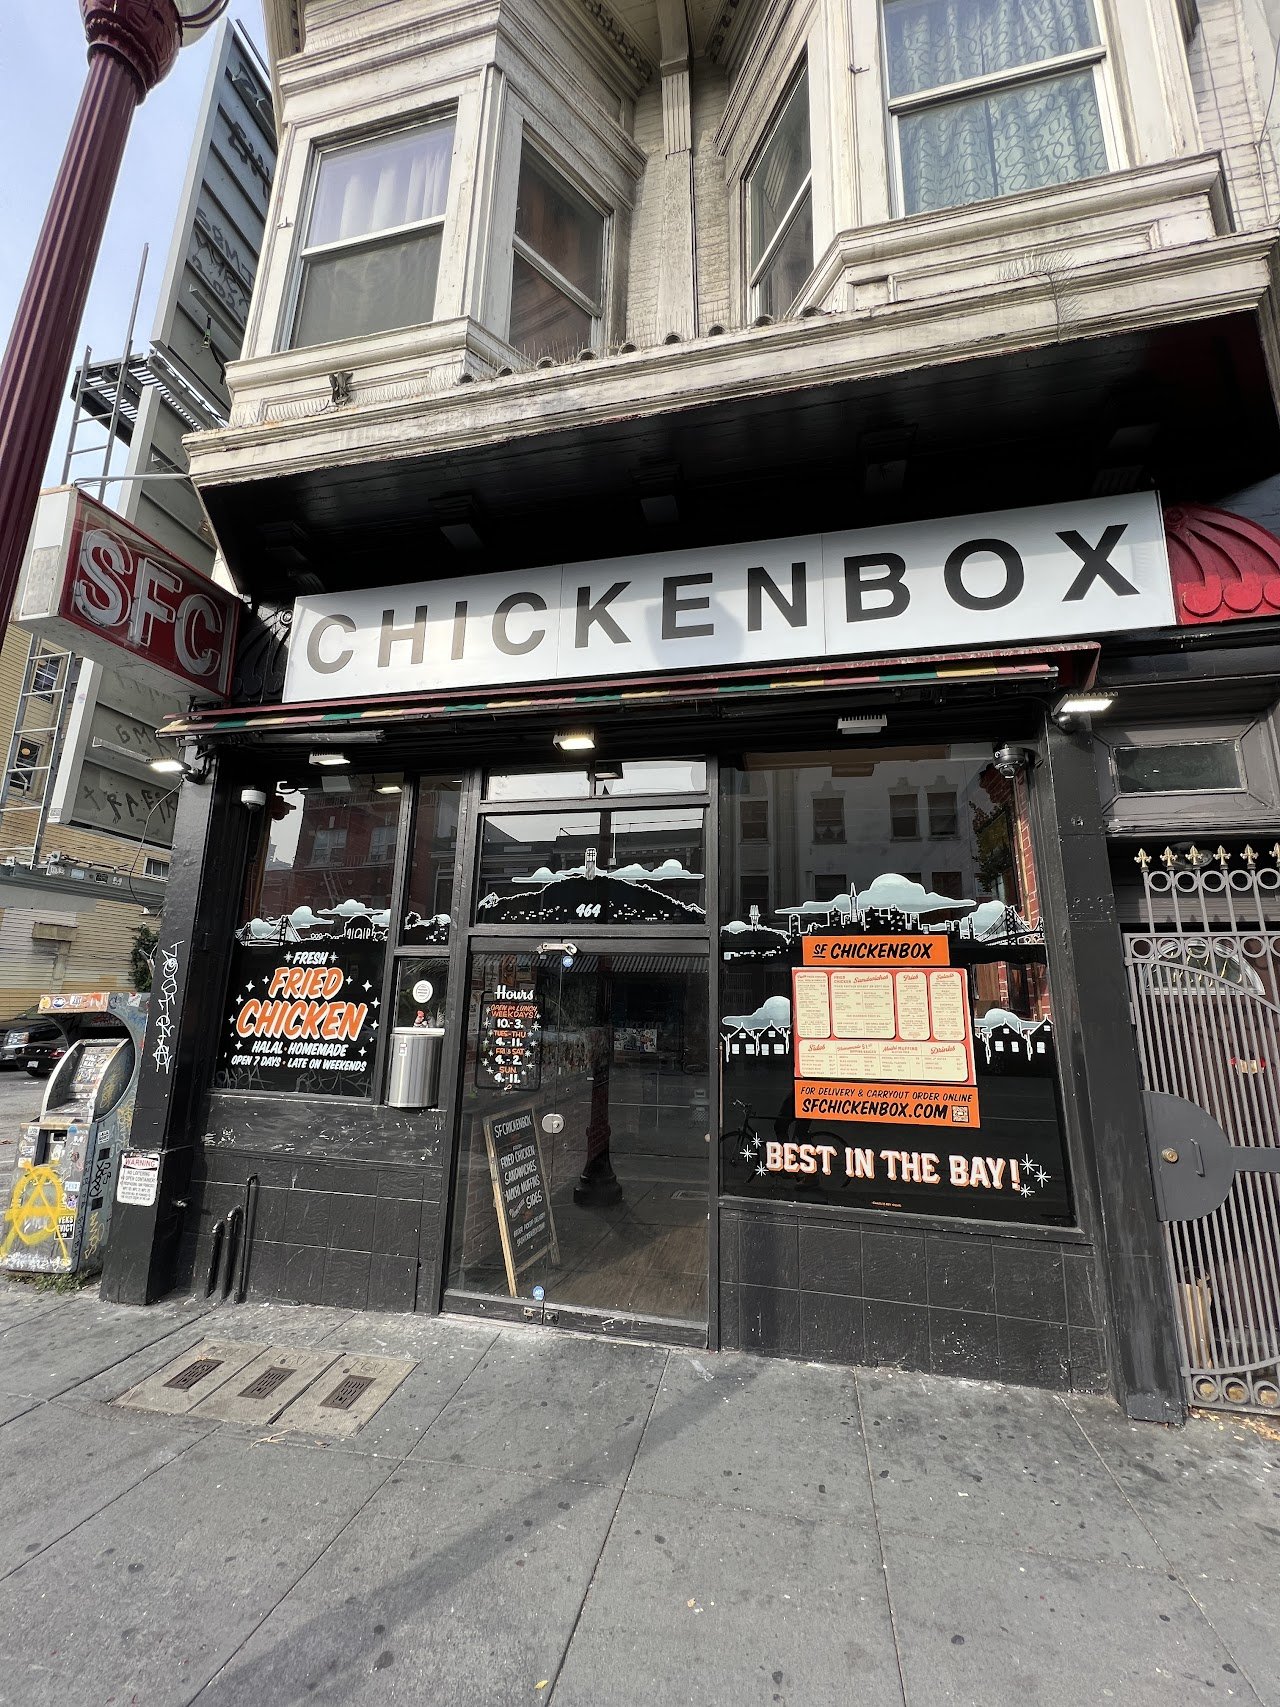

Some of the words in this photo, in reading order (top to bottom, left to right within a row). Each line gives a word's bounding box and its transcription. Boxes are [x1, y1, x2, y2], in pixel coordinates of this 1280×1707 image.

[73, 528, 223, 677] SFC
[306, 523, 1139, 673] CHICKENBOX
[575, 903, 602, 918] 464
[292, 952, 329, 964] FRESH
[812, 944, 828, 958] SF
[830, 942, 933, 959] CHICKENBOX
[268, 966, 344, 1000] FRIED
[494, 984, 534, 1000] Hours
[236, 998, 368, 1041] CHICKEN
[252, 1040, 284, 1054] HALAL
[287, 1042, 349, 1057] HOMEMADE
[230, 1054, 253, 1066] OPEN
[254, 1056, 260, 1066] 7
[260, 1056, 282, 1067] DAYS
[287, 1058, 309, 1068] LATE
[309, 1059, 322, 1069] ON
[322, 1060, 368, 1072] WEEKENDS
[818, 1087, 856, 1097] DELIVERY
[867, 1090, 910, 1099] CARRYOUT
[913, 1092, 940, 1100] ORDER
[942, 1093, 973, 1103] ONLINE
[802, 1098, 948, 1119] SFCHICKENBOX.COM
[126, 1159, 155, 1167] WARNING
[766, 1142, 838, 1175] BEST
[844, 1146, 875, 1178] IN
[879, 1150, 940, 1184] THE
[949, 1154, 1021, 1191] BAY!
